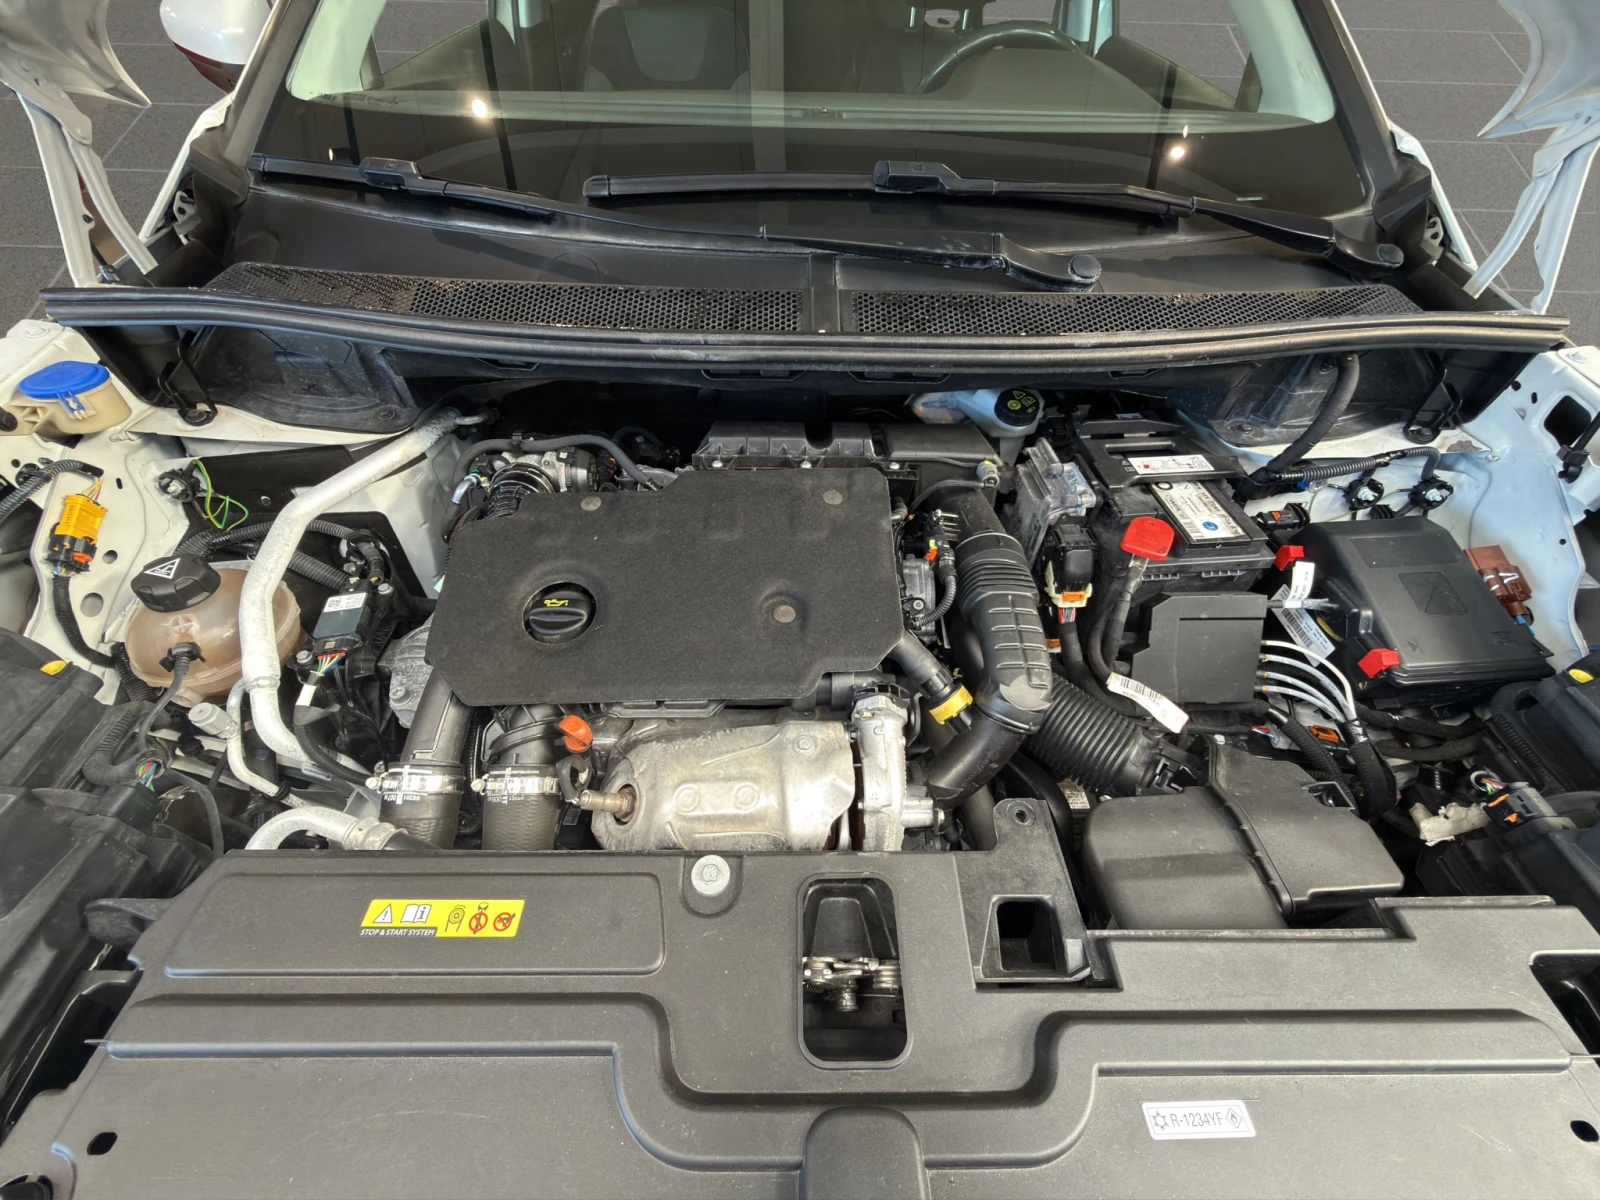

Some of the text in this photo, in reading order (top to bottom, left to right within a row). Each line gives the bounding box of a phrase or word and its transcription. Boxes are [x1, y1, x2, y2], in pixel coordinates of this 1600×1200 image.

[360, 928, 380, 936] STOP
[385, 928, 408, 936] START
[407, 928, 436, 936] SYSTEM
[1169, 1111, 1222, 1128] R-1234YF
